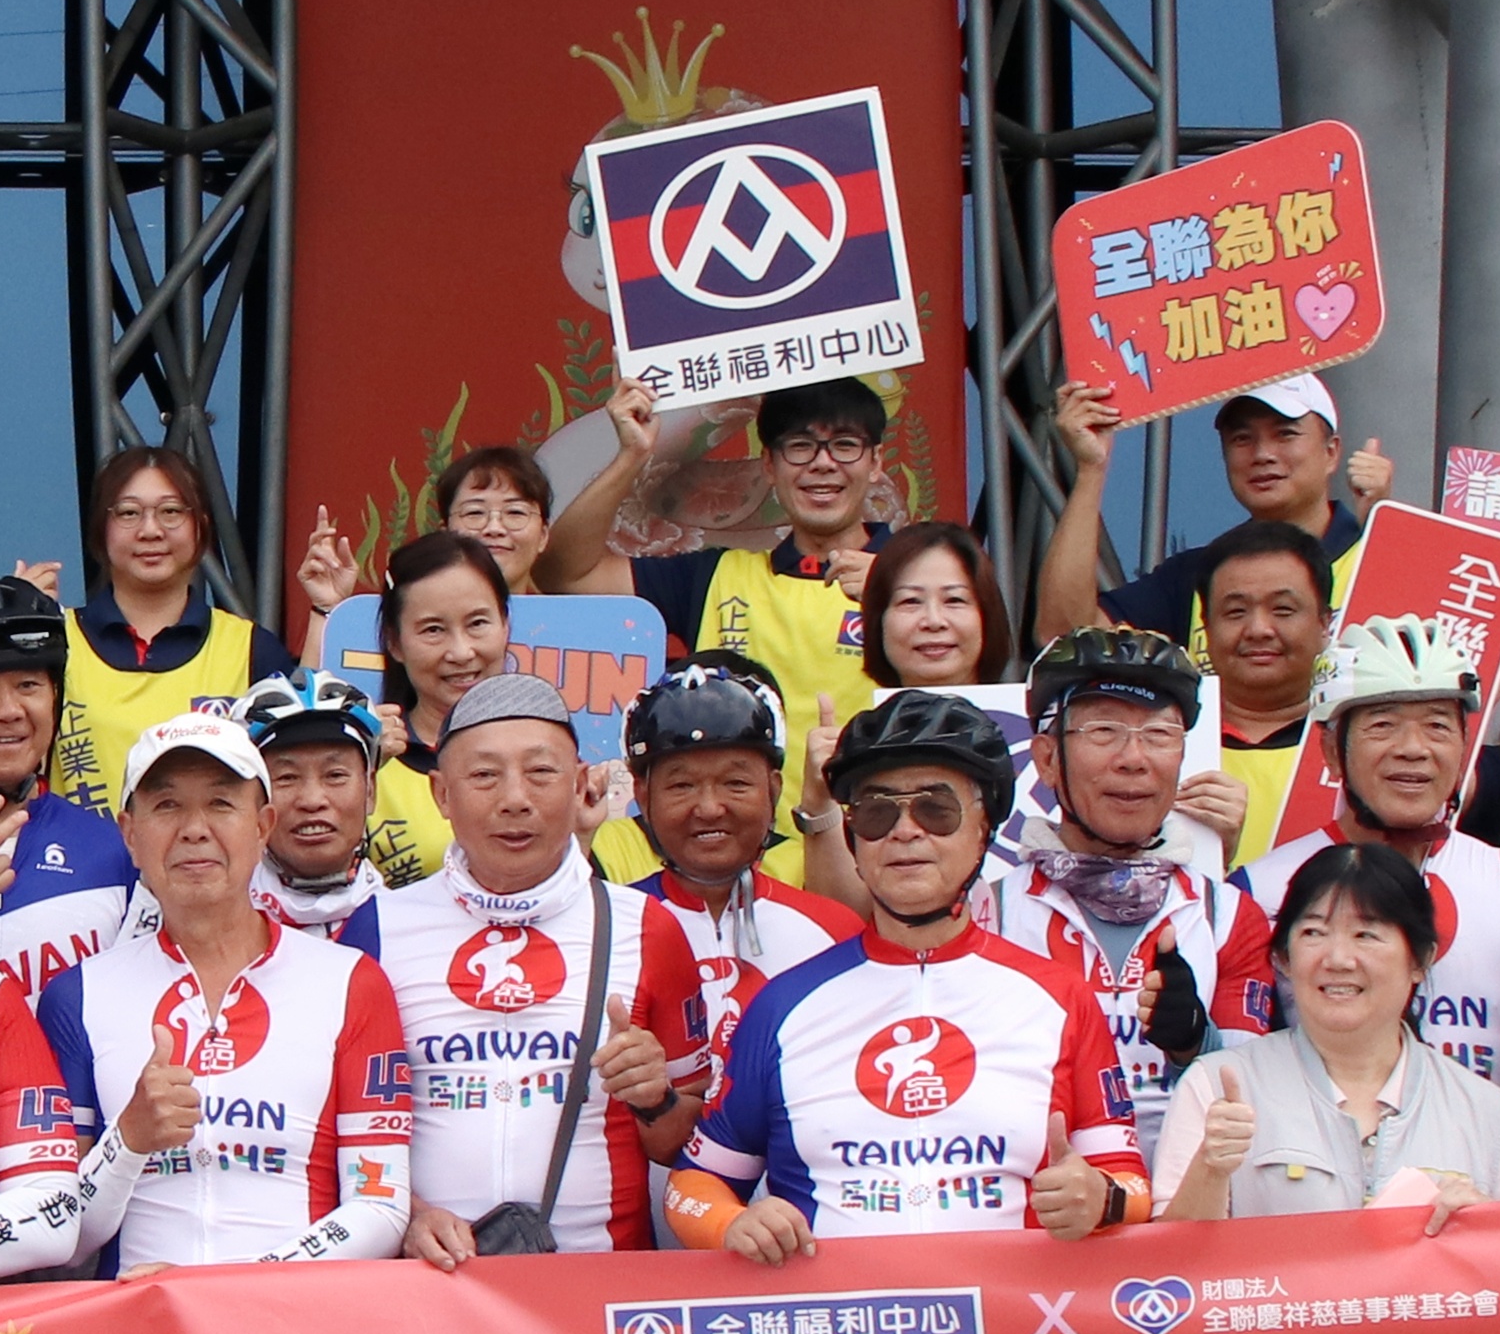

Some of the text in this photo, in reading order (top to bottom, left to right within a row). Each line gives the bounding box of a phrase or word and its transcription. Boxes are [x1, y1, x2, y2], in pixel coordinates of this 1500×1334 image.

[1090, 190, 1339, 298] 全聯為你
[1160, 280, 1288, 362] 加油
[637, 320, 911, 401] 全聯福利中心
[1100, 683, 1156, 701] Elevate
[832, 1134, 1006, 1167] TAIWAN
[1201, 1275, 1288, 1299] 財團法人
[1202, 1288, 1500, 1334] 全聯慶祥慈善事業基金會
